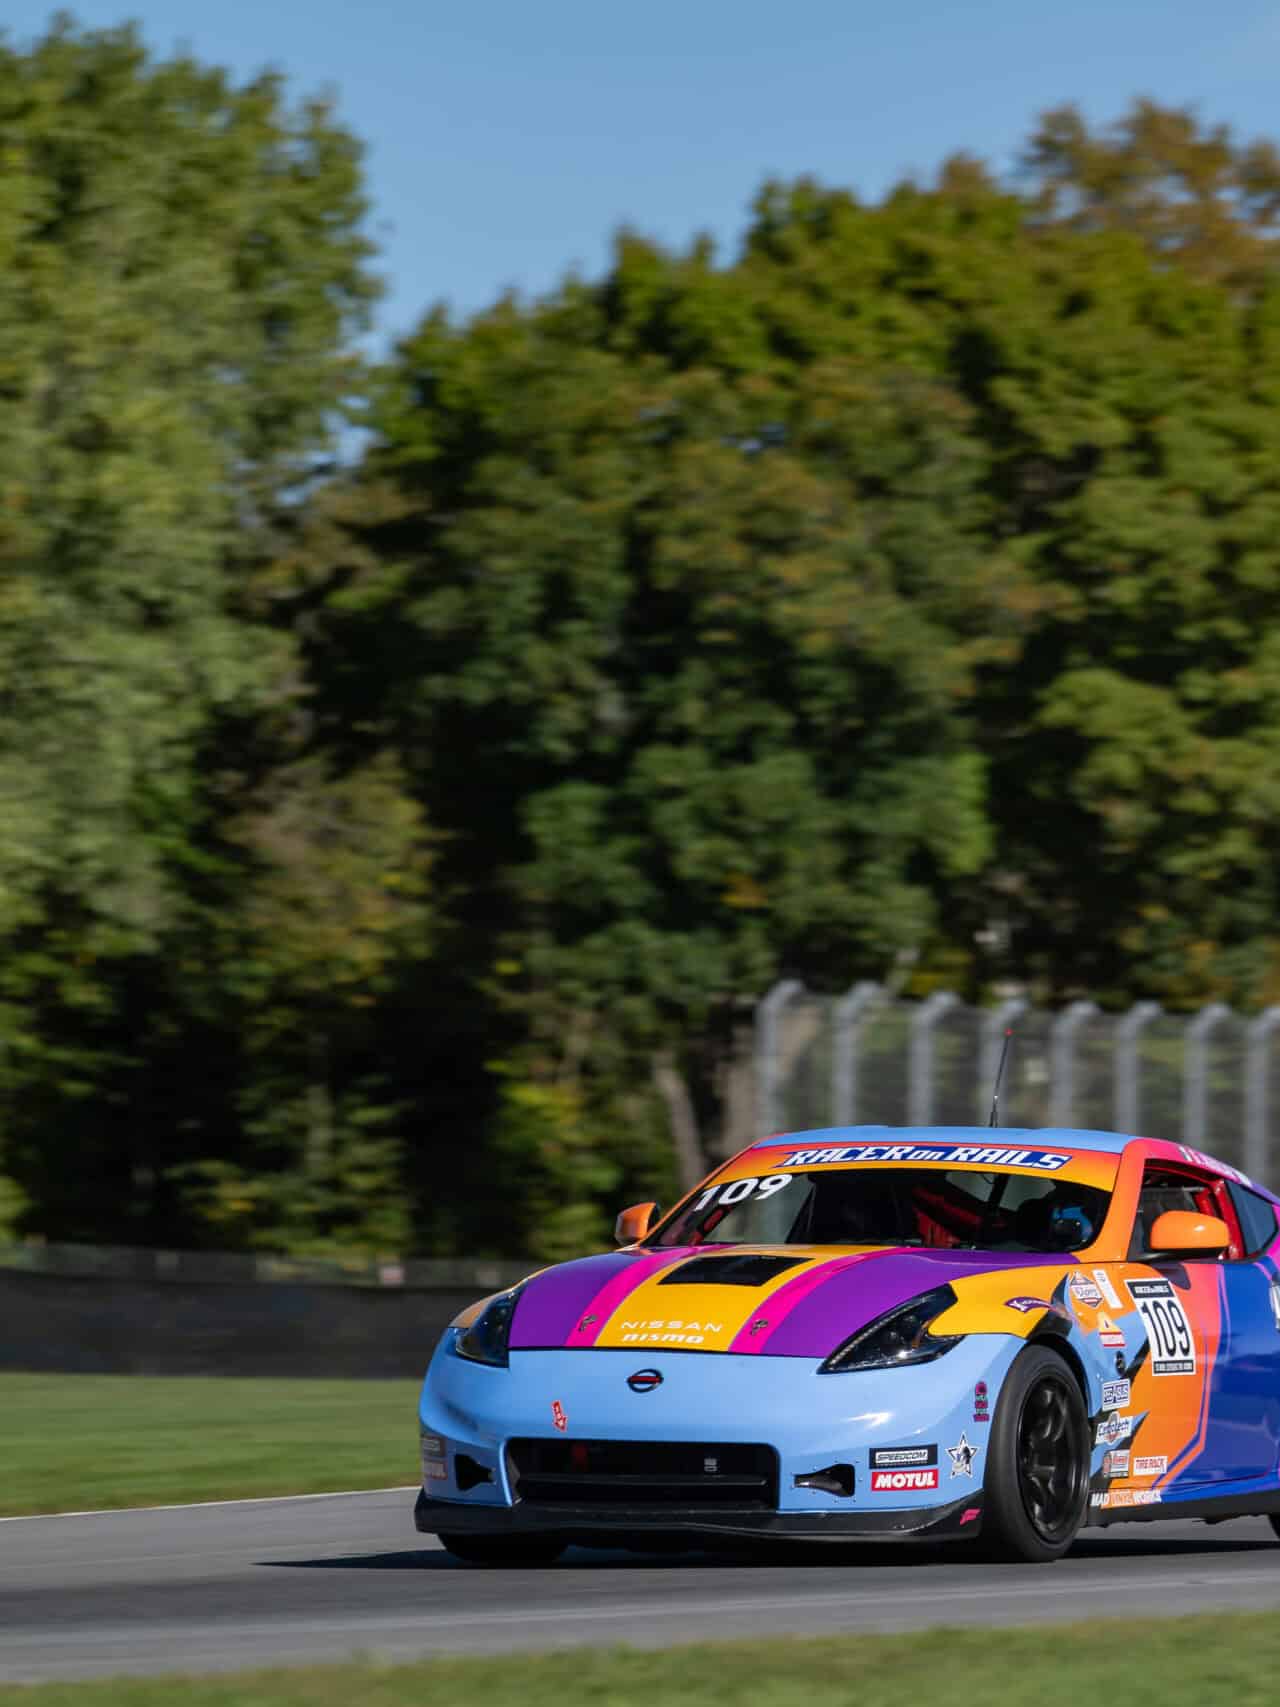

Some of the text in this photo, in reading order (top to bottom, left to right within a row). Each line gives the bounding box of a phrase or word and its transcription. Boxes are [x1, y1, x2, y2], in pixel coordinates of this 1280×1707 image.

[784, 1146, 917, 1167] RACER
[944, 1147, 1068, 1170] RAILS
[693, 1174, 793, 1211] 109
[621, 1320, 722, 1332] NISSAN
[1141, 1300, 1190, 1357] 109
[874, 1471, 936, 1489] MOTUL
